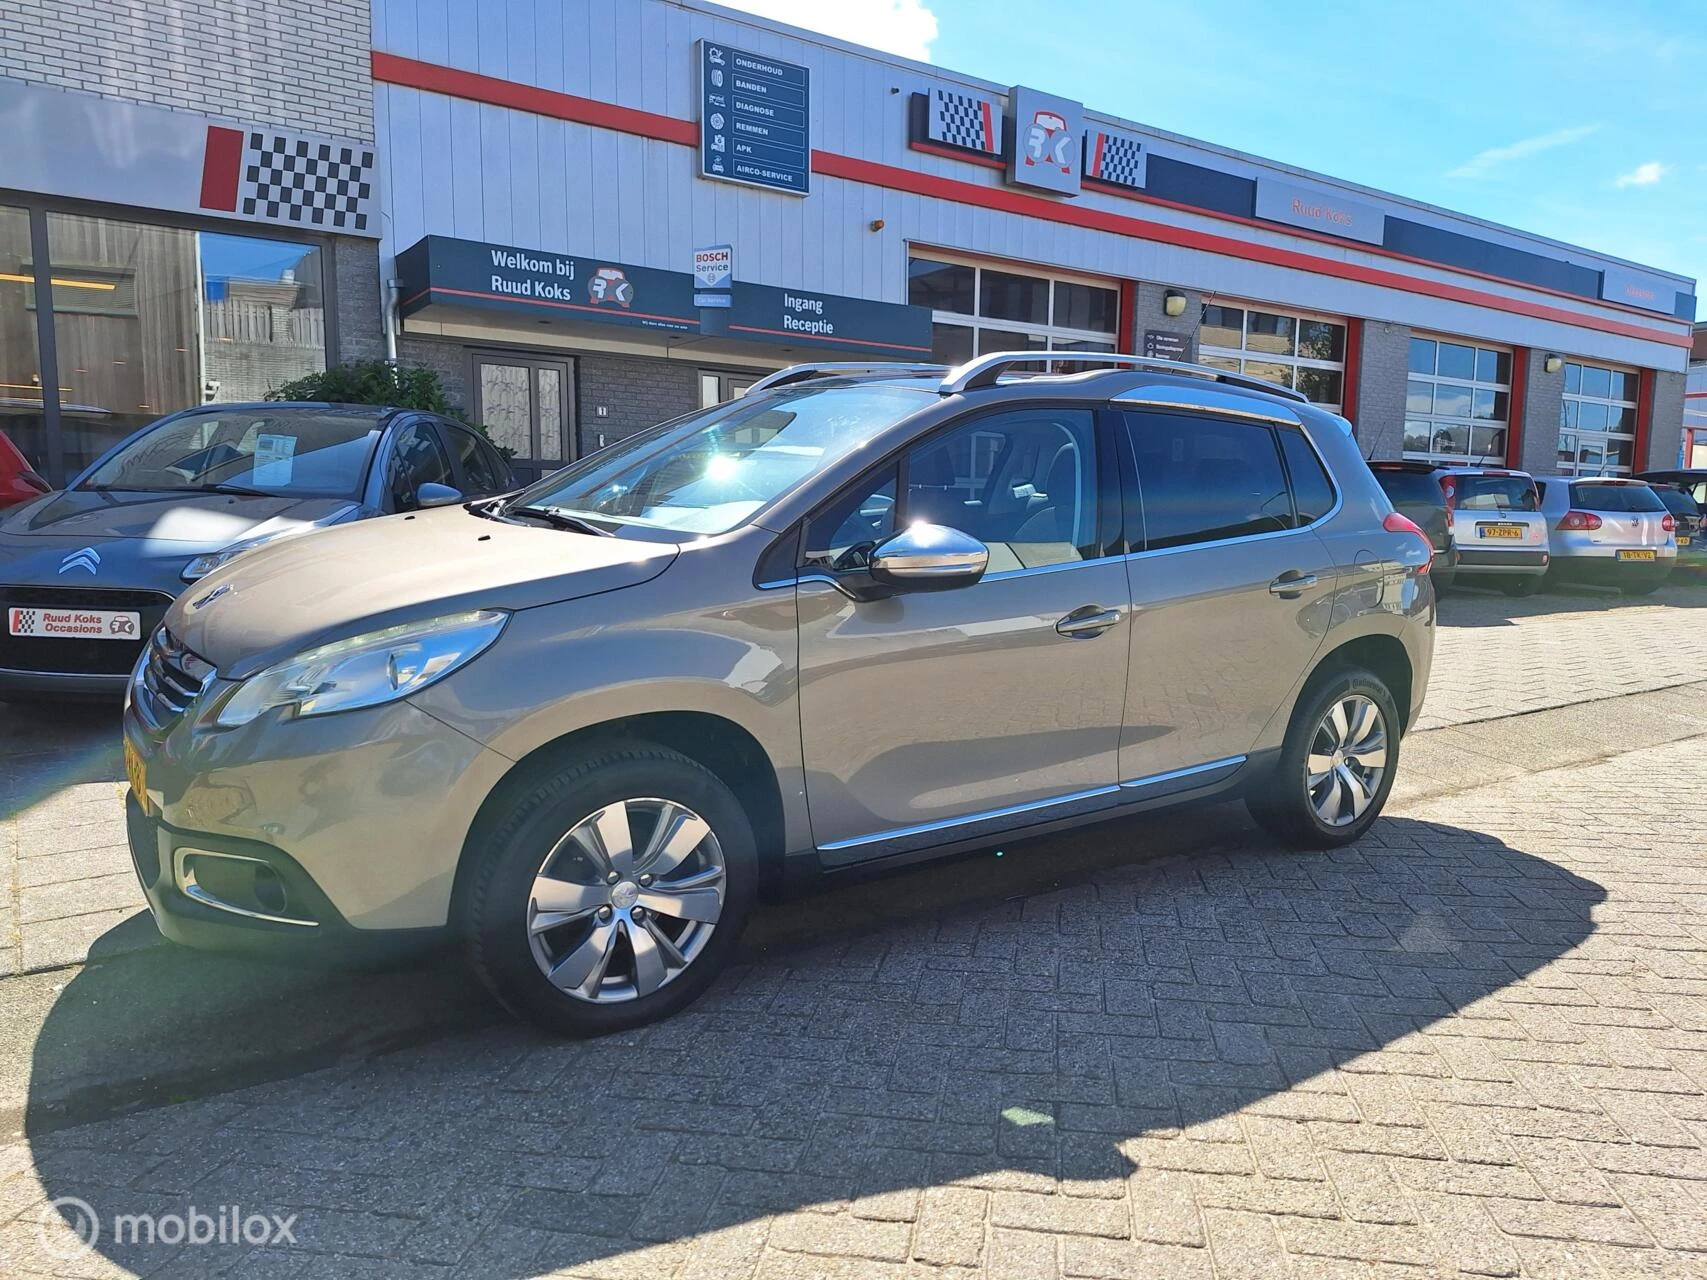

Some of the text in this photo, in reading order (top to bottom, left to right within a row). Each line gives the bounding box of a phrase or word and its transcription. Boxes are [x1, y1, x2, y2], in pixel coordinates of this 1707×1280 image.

[735, 58, 783, 76] ONDERHOUD
[735, 80, 767, 93] BANDEN
[735, 101, 775, 117] DIAGNOSE
[735, 122, 769, 135] REMMEN
[736, 144, 753, 153] APK
[736, 165, 793, 182] AIRCO-SERVICE
[1292, 198, 1321, 217] Ruud
[491, 250, 575, 280] Welkom bij
[695, 251, 729, 263] BOSCH
[695, 263, 729, 273] Service
[491, 275, 571, 301] Ruud Koks
[784, 293, 823, 315] Ingang
[783, 314, 834, 335] Receptie
[43, 613, 102, 624] Ruud Koks
[45, 623, 103, 634] Occasions
